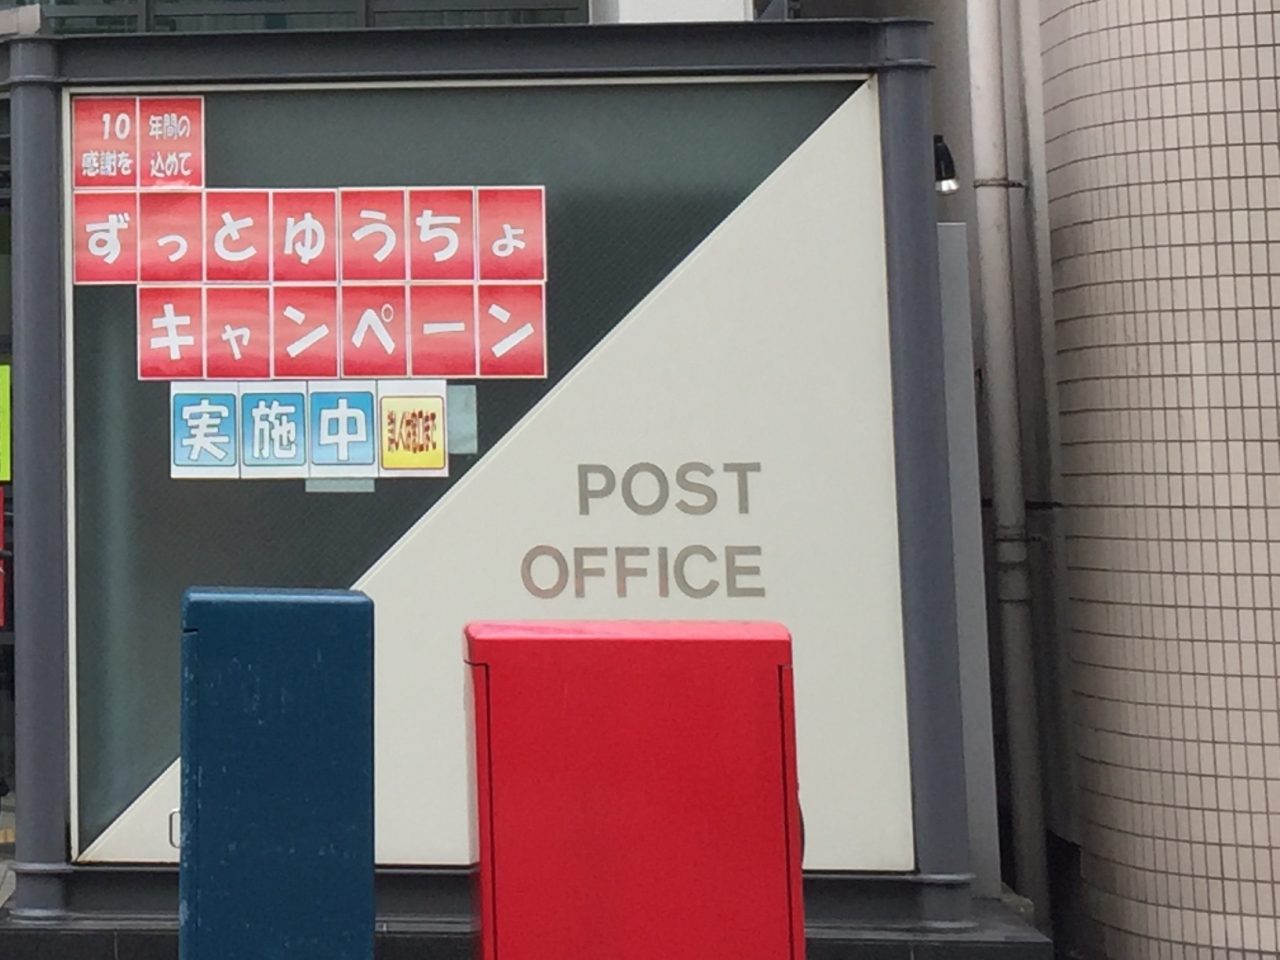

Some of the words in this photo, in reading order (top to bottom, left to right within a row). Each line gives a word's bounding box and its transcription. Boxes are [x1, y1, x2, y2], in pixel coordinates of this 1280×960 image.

[85, 210, 526, 265] ずっとゆうちょ
[150, 303, 535, 360] キャンペーン
[180, 398, 368, 462] 実施中
[577, 461, 762, 516] POST
[521, 544, 766, 599] OFFICE
